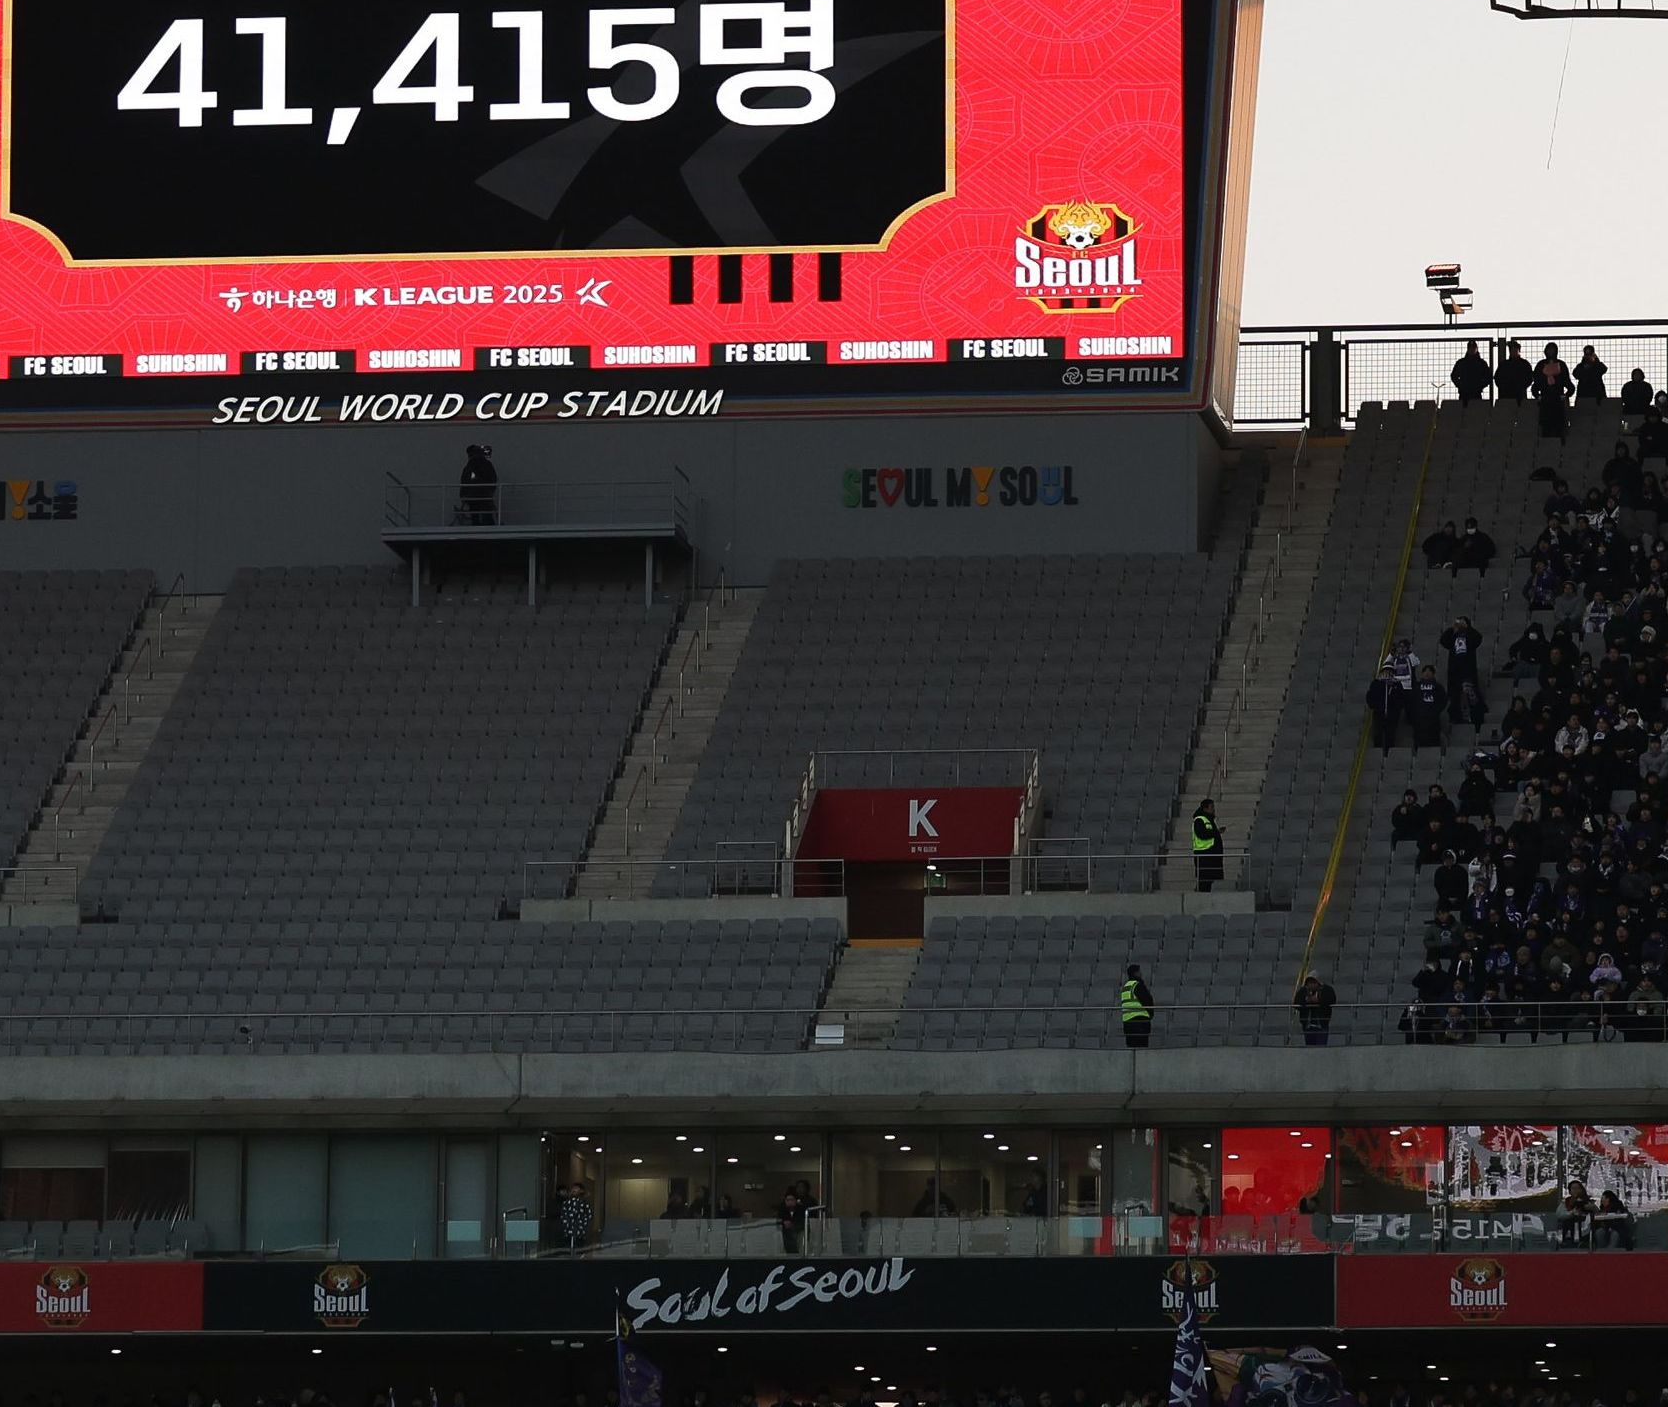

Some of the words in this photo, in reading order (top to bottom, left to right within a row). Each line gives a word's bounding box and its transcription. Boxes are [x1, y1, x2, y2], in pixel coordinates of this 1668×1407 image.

[1015, 236, 1143, 288] Seoul
[252, 287, 337, 309] 하나은행
[354, 287, 378, 306] K
[383, 286, 494, 306] LEAGUE
[503, 285, 564, 304] 2025
[25, 357, 46, 375] FC
[51, 356, 106, 374] SEOUL
[137, 354, 227, 373] SUHOSHIN
[256, 353, 277, 370] FC
[283, 352, 340, 370] SEOUL
[369, 349, 461, 368] SUHOSHIN
[491, 349, 512, 366] FC
[518, 348, 573, 366] SEOUL
[604, 346, 696, 364] SUHOSHIN
[726, 344, 747, 362] FC
[753, 343, 810, 361] SEOUL
[841, 341, 933, 359] SUHOSHIN
[964, 340, 985, 358] FC
[991, 339, 1048, 357] SEOUL
[1079, 337, 1171, 355] SUHOSHIN
[1086, 367, 1179, 383] SAMIK
[212, 396, 322, 424] SEOUL
[339, 394, 464, 421] WORLD
[475, 393, 549, 420] CUP
[557, 390, 724, 417] STADIUM
[908, 799, 939, 837] K
[36, 1283, 91, 1313] Seoul
[314, 1283, 370, 1313] Seoul
[735, 1266, 784, 1314] of
[777, 1258, 915, 1311] Seoul
[1161, 1279, 1220, 1310] Seul
[1450, 1278, 1508, 1308] Seoul
